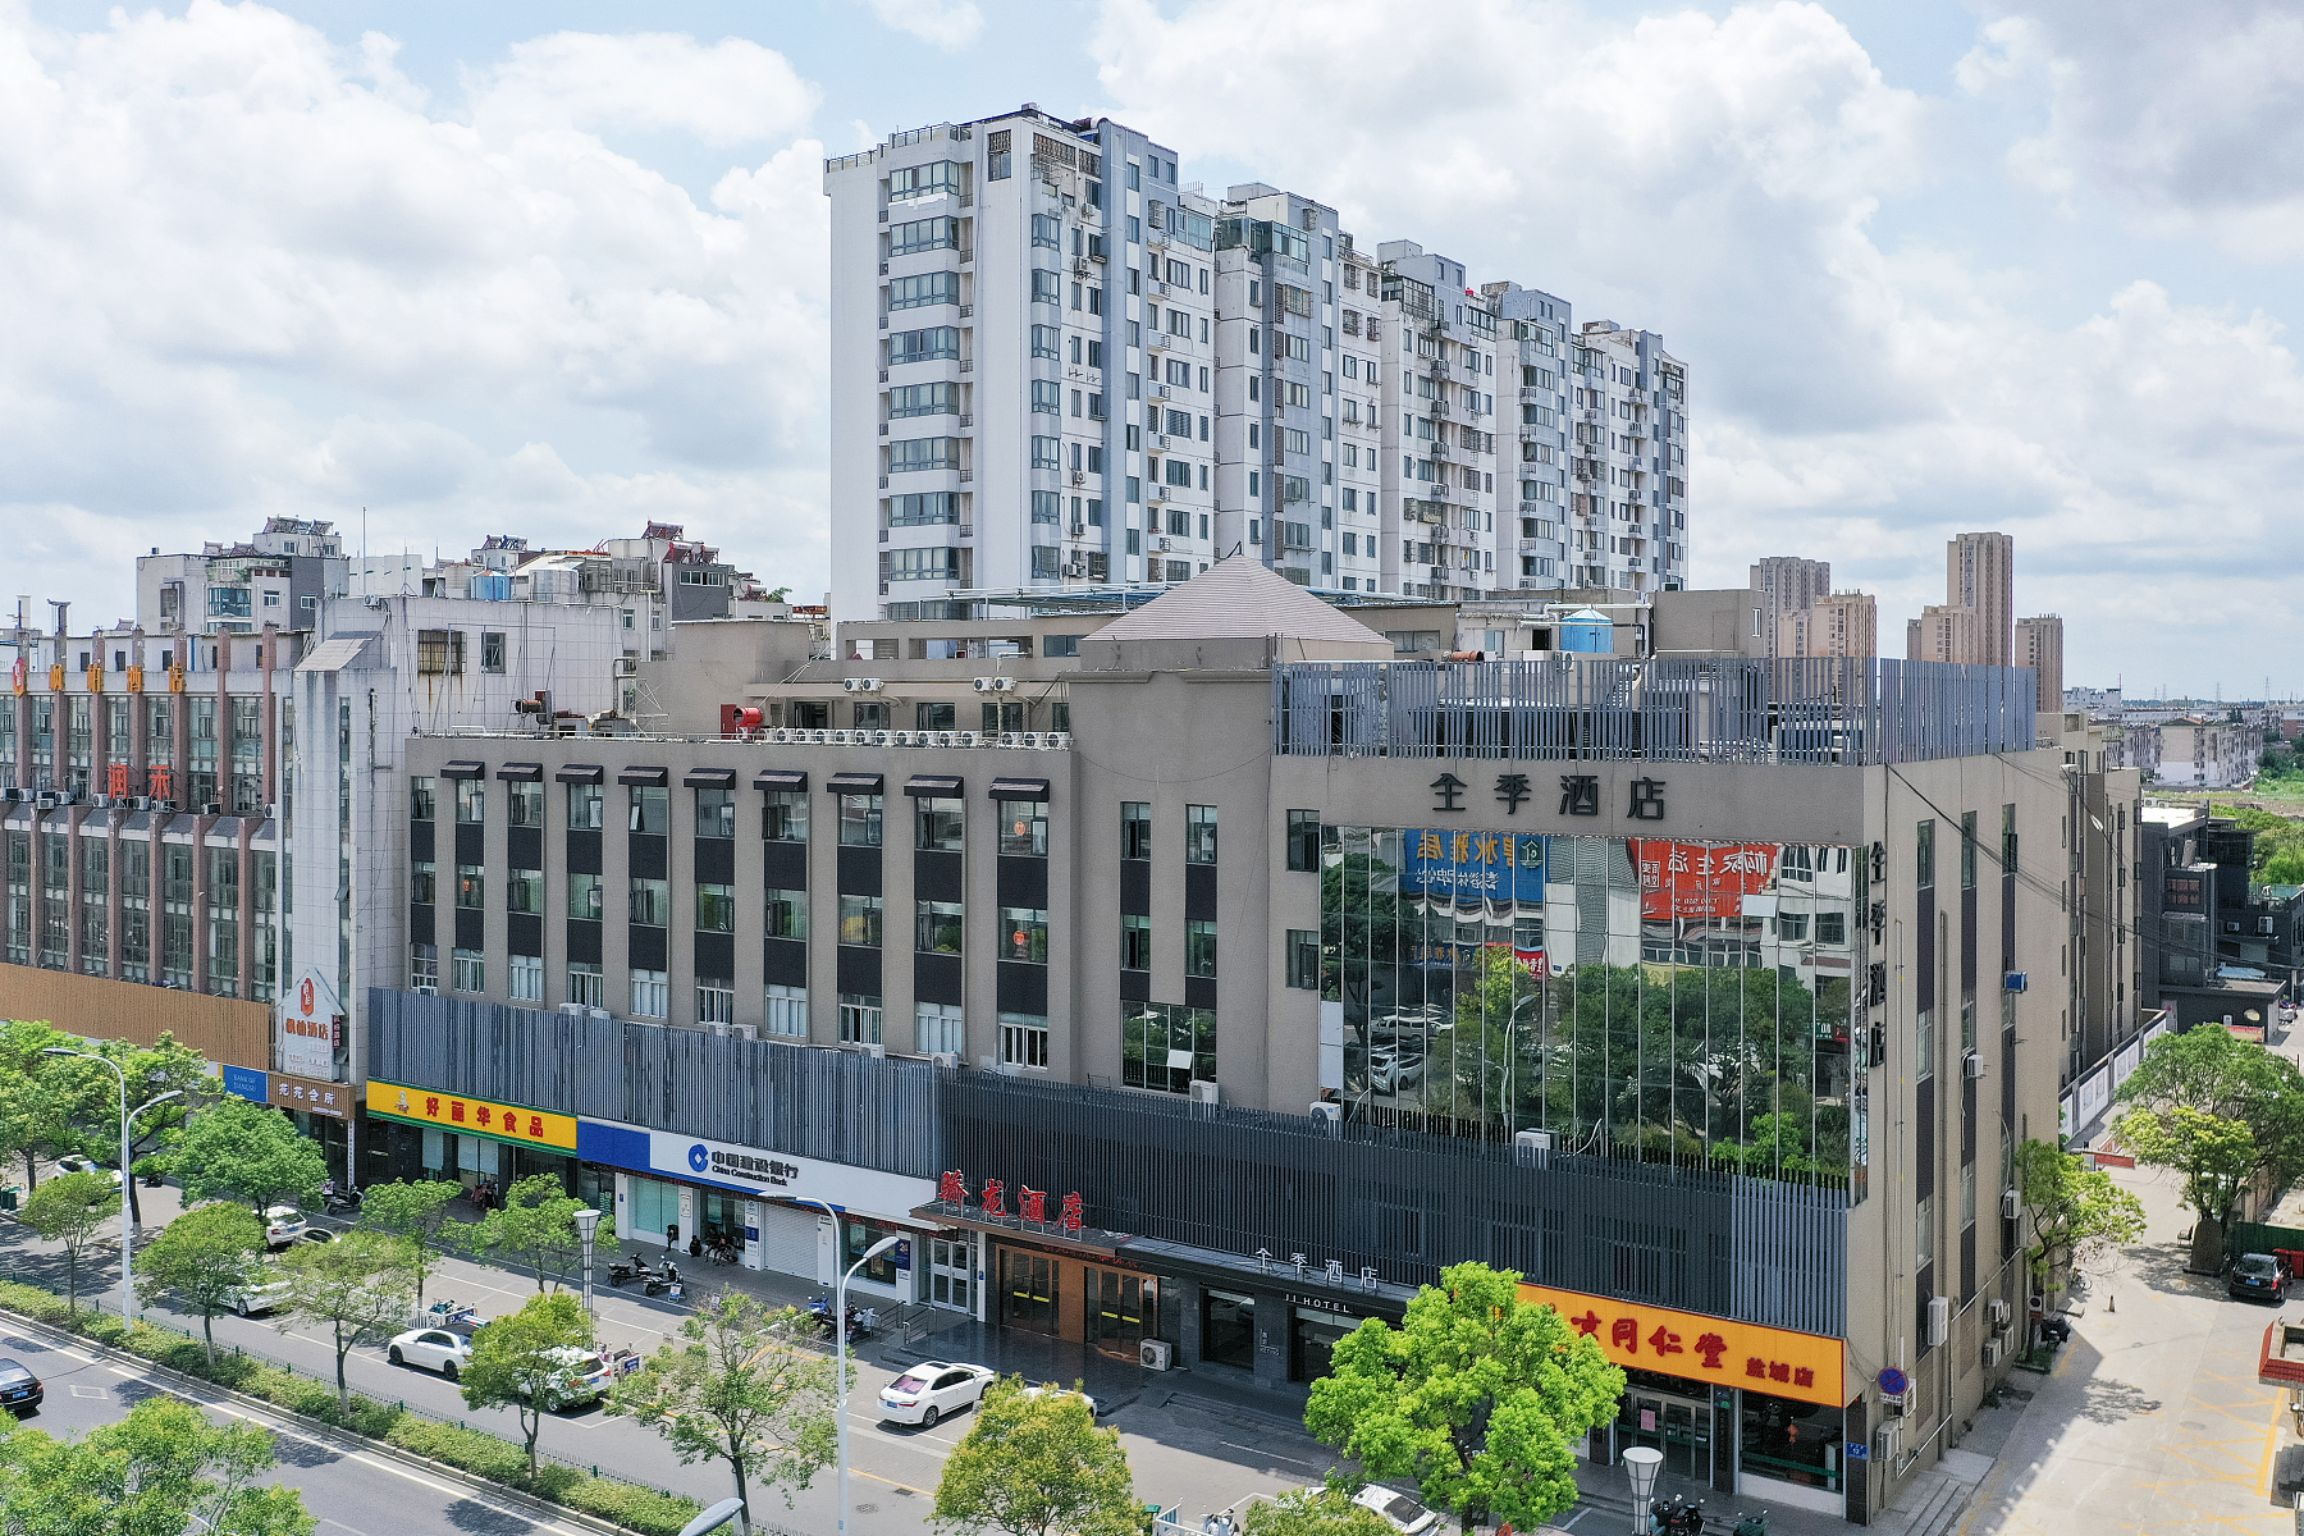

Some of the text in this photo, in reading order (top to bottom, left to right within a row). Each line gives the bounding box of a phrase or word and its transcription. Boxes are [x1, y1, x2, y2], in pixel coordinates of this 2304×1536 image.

[1429, 772, 1666, 820] 全季酒店
[1870, 840, 1886, 1068] 全季酒店
[425, 1096, 544, 1138] 好丽华食品
[711, 1150, 799, 1179] 中国建设银行
[711, 1164, 788, 1186] China Construction Bank
[1255, 1247, 1378, 1290] 全季酒店
[1303, 1297, 1351, 1313] HOTEL
[1571, 1309, 1728, 1369] 京同仁堂
